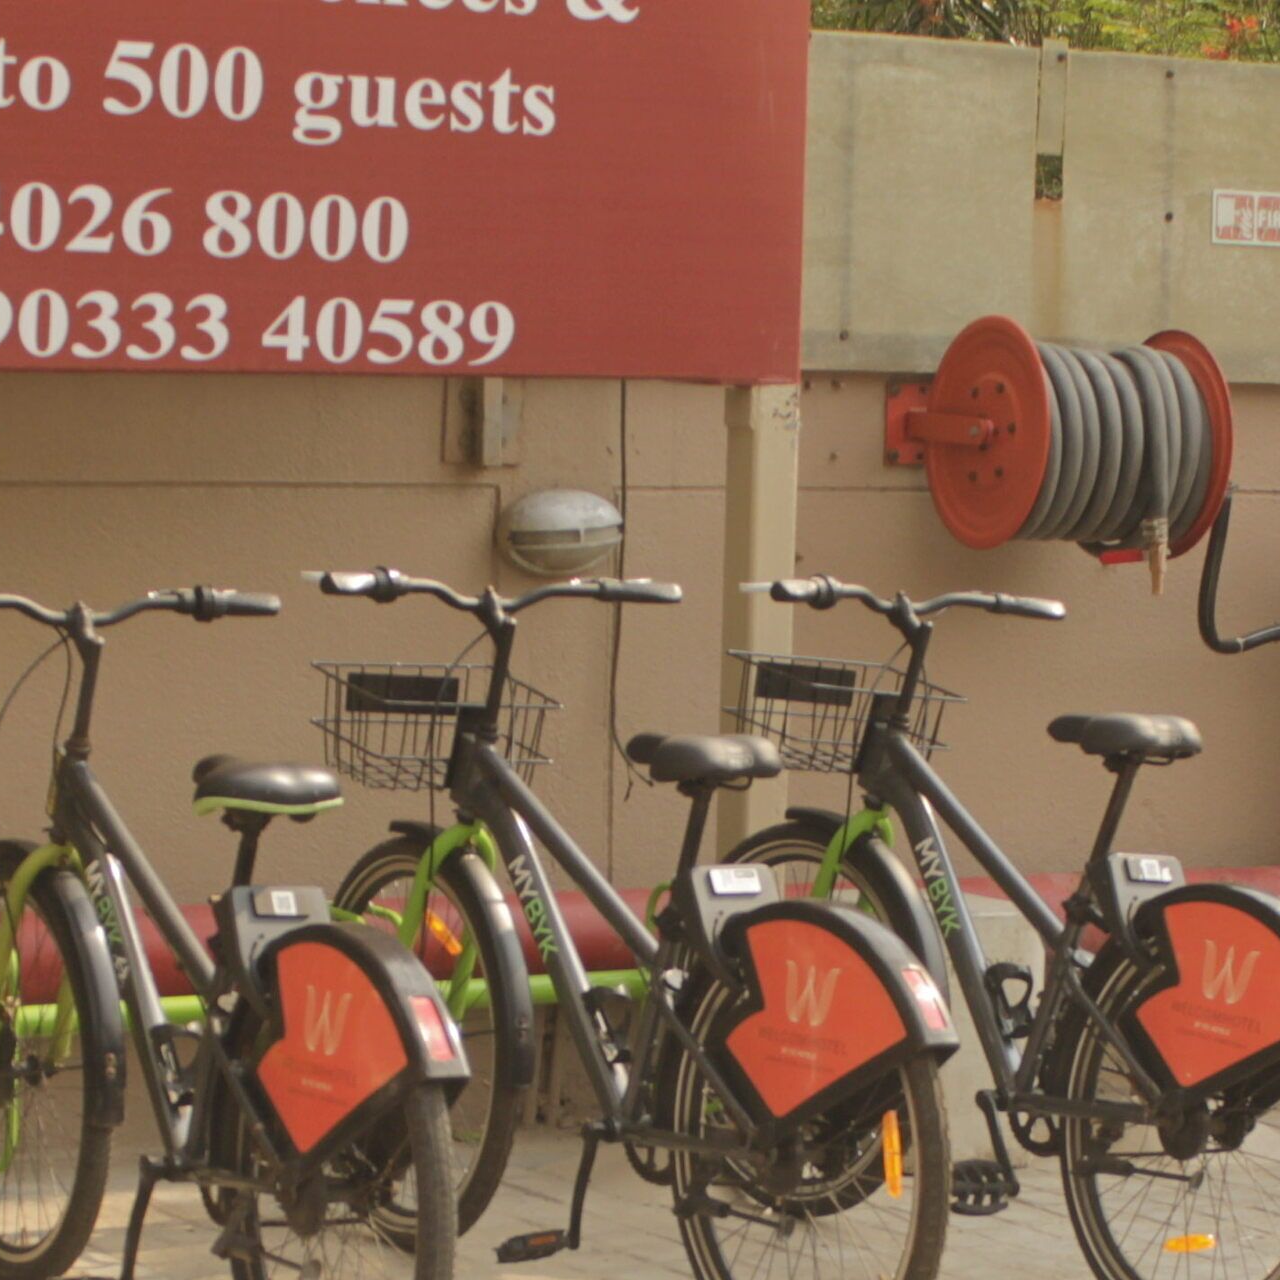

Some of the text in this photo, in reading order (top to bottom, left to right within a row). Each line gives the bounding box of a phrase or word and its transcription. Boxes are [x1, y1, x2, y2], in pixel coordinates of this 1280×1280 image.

[102, 40, 264, 121] 500
[292, 69, 556, 146] guests
[202, 190, 409, 263] 8000
[261, 295, 515, 366] 40589
[508, 854, 559, 963] MYBYK
[915, 837, 961, 938] MYBYK
[785, 959, 842, 1027] W
[1202, 938, 1261, 1005] W
[304, 984, 353, 1056] W
